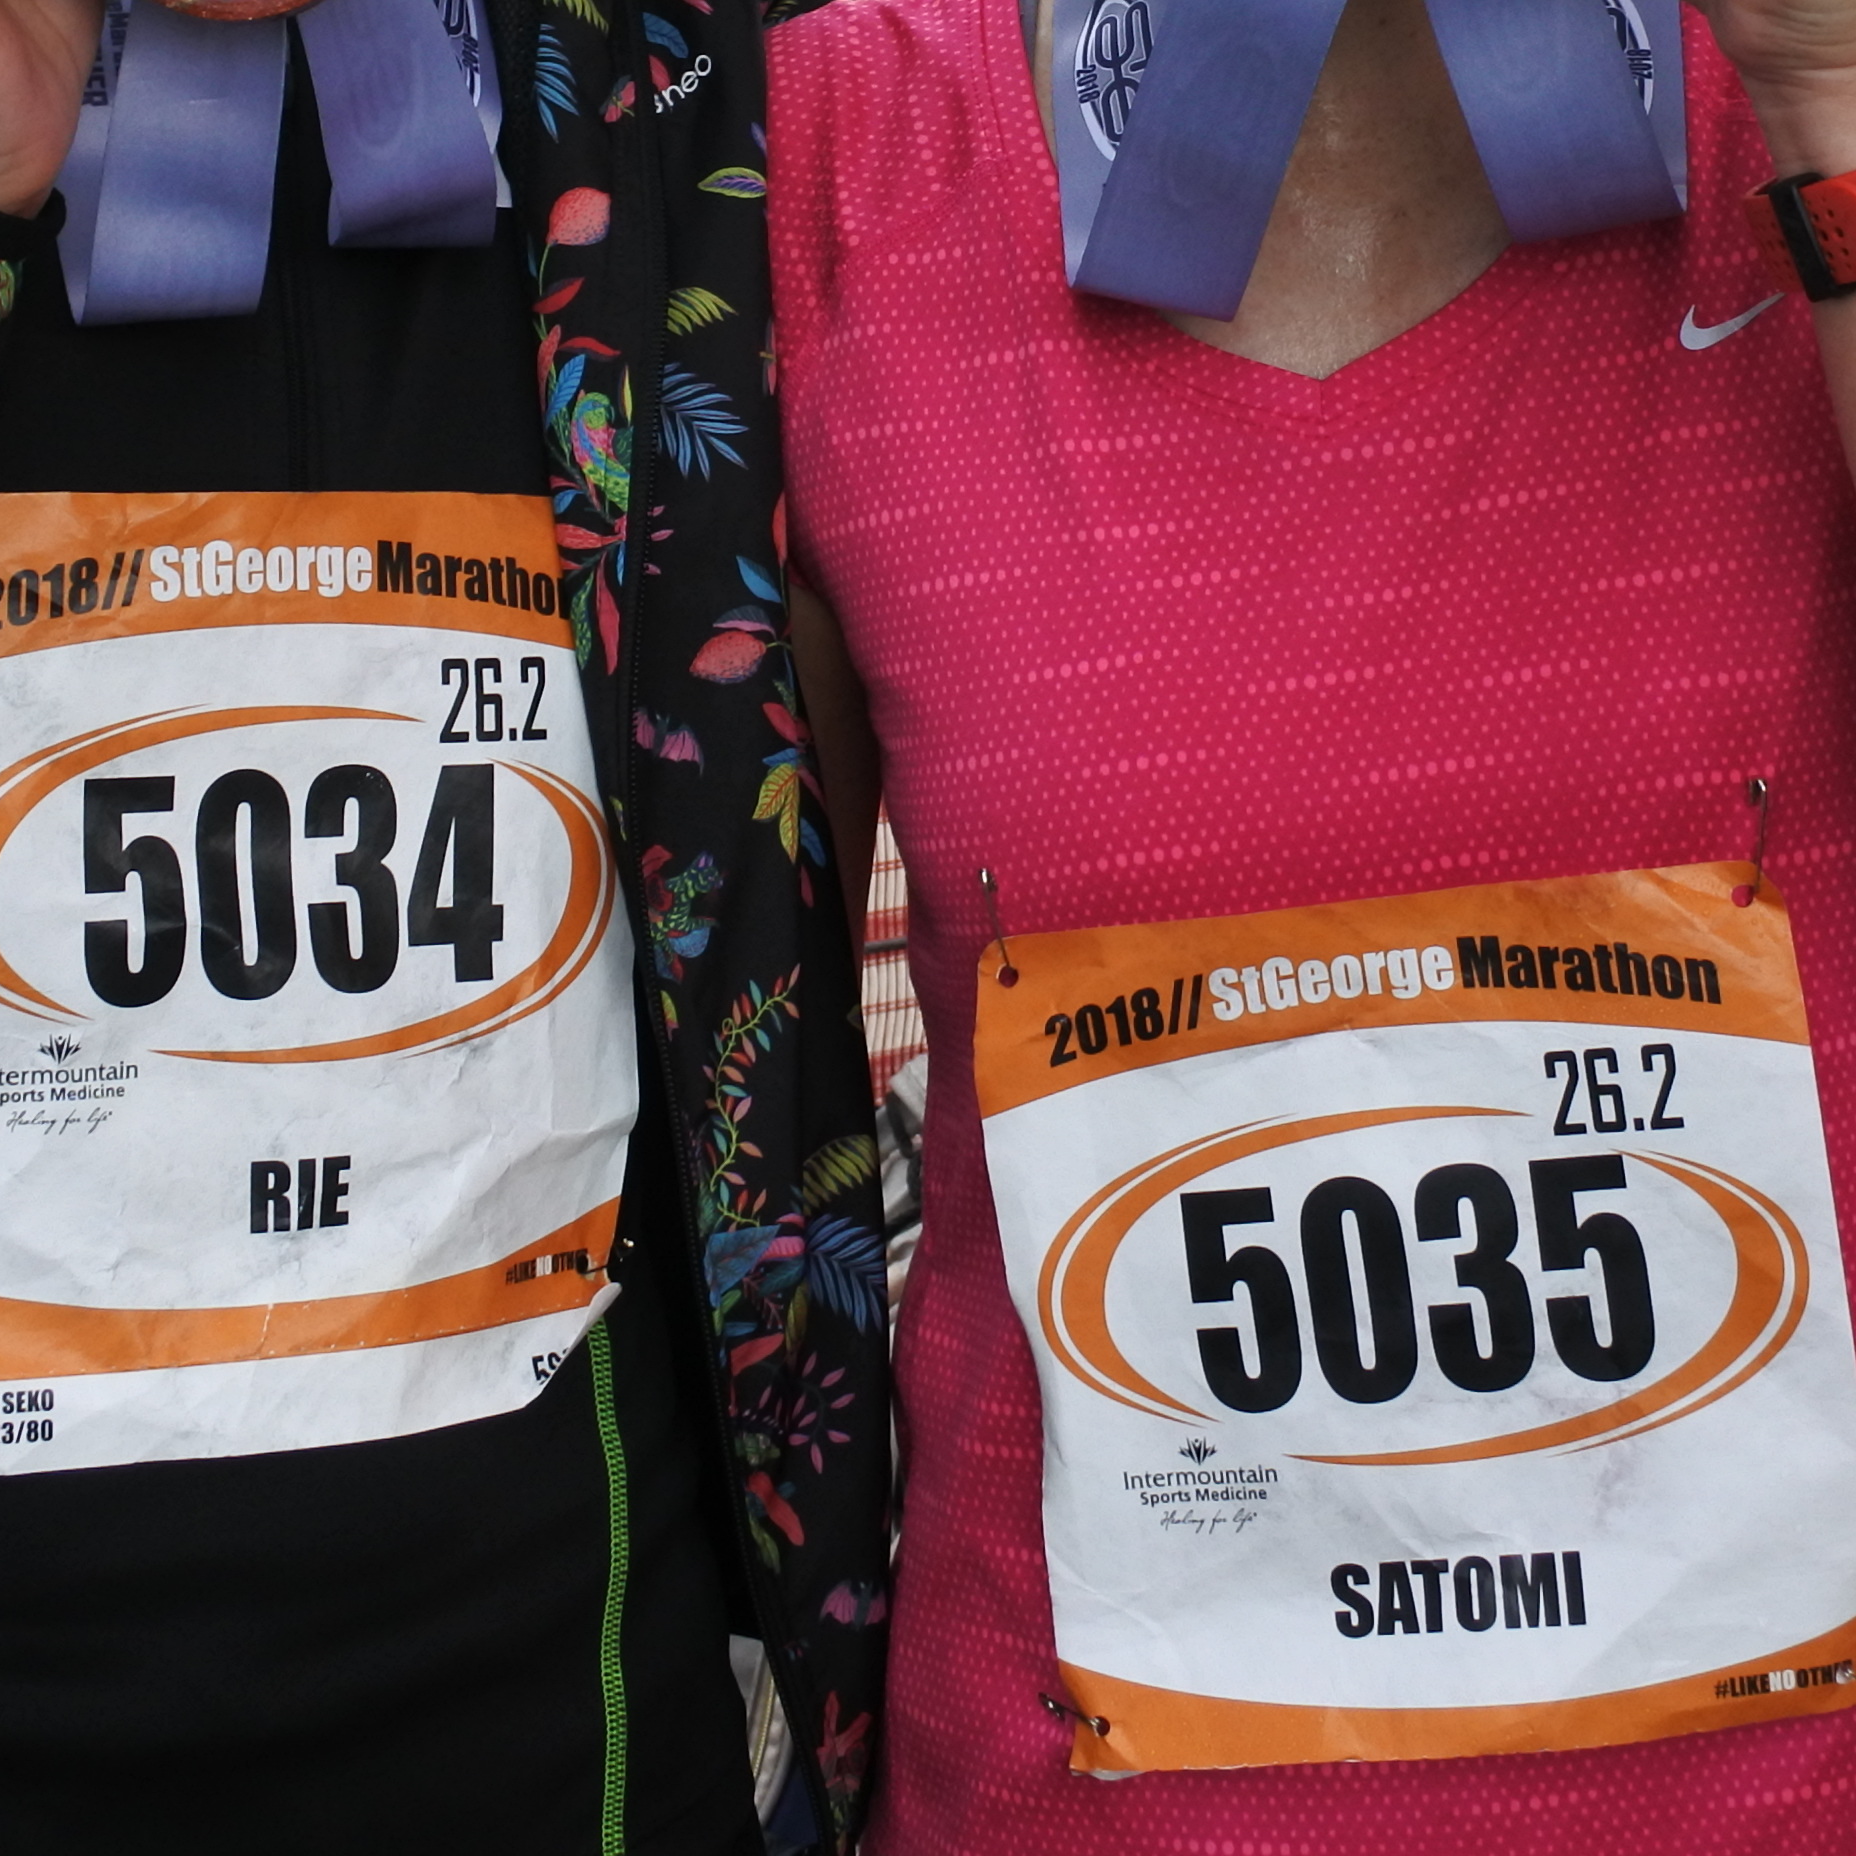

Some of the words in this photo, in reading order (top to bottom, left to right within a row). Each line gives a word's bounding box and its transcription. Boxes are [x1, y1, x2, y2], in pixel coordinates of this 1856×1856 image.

[1626, 48, 1655, 80] 2018
[1075, 63, 1101, 105] 2018
[438, 656, 548, 745] 26.2
[82, 762, 505, 1009] 5034
[50, 1083, 126, 1102] Medicine
[1543, 1042, 1686, 1137] 26.2
[5, 1109, 58, 1136] Healing
[58, 1108, 82, 1136] for
[248, 1154, 352, 1235] RIE
[1179, 1153, 1657, 1415] 5035
[1, 1388, 55, 1415] SEKO
[1122, 1464, 1279, 1491] Intermountain
[1139, 1490, 1192, 1508] Sports
[1195, 1486, 1268, 1502] Medicine
[1159, 1508, 1205, 1534] Healing
[1208, 1509, 1228, 1535] for
[1329, 1549, 1588, 1640] SATOMI
